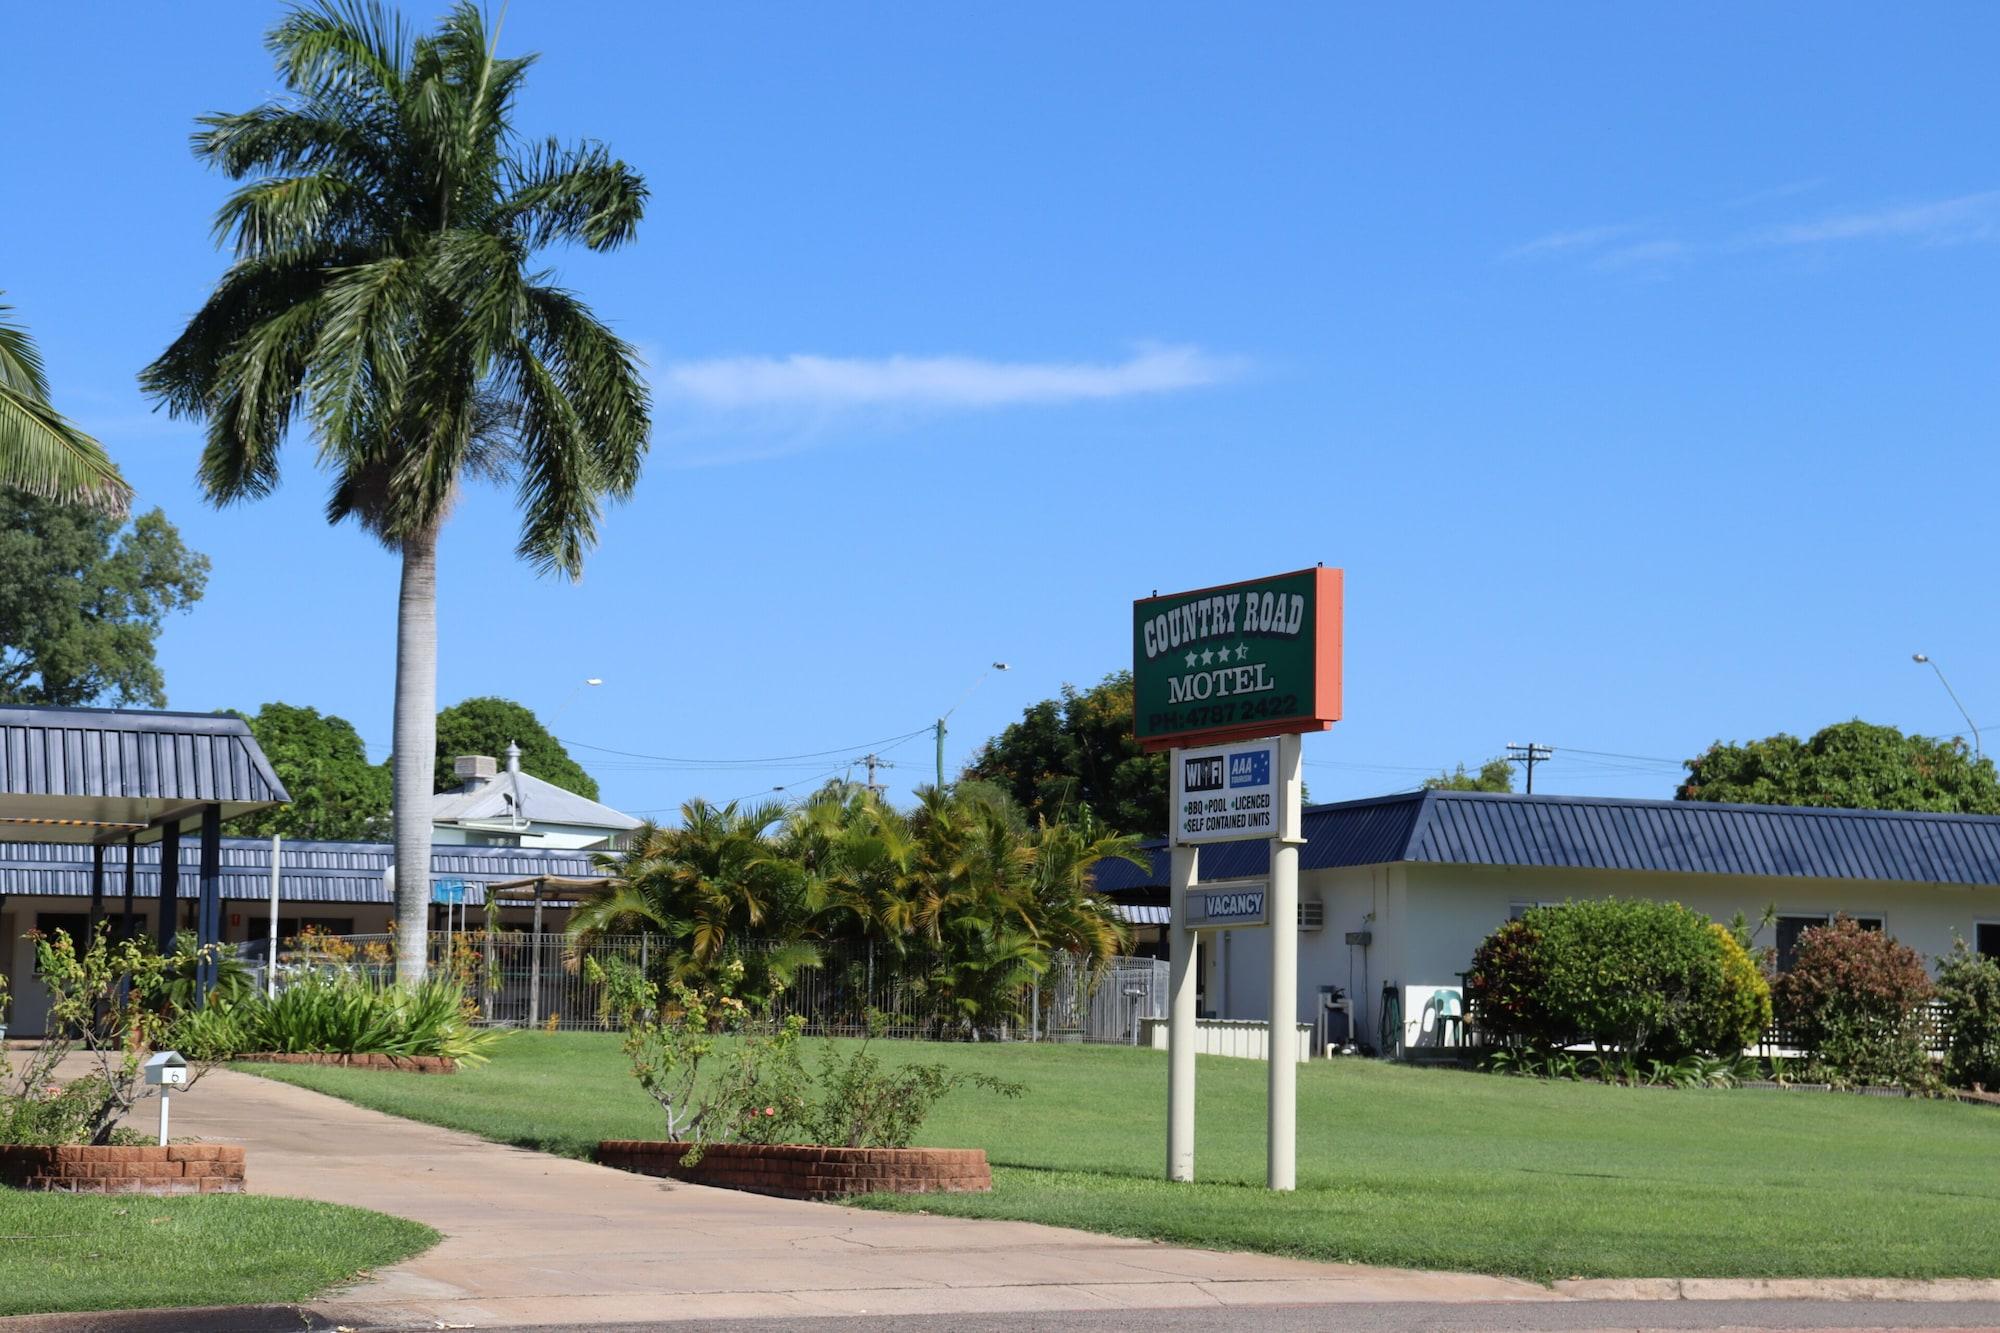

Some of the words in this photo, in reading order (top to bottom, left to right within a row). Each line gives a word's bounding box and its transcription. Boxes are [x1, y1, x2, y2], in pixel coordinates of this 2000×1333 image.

[1144, 593, 1240, 658] COUNTRY
[1243, 591, 1304, 635] ROAD
[1168, 663, 1274, 704] MOTEL
[1241, 694, 1297, 719] 2422
[1231, 757, 1252, 775] AAA
[1188, 800, 1203, 815] BBQ
[1208, 798, 1227, 813] POOL
[1235, 794, 1270, 811] LICENCED
[1187, 818, 1204, 832] SELF
[1206, 814, 1246, 831] CONTAINED
[1248, 812, 1270, 827] UNITS
[1207, 893, 1263, 916] VACANCY
